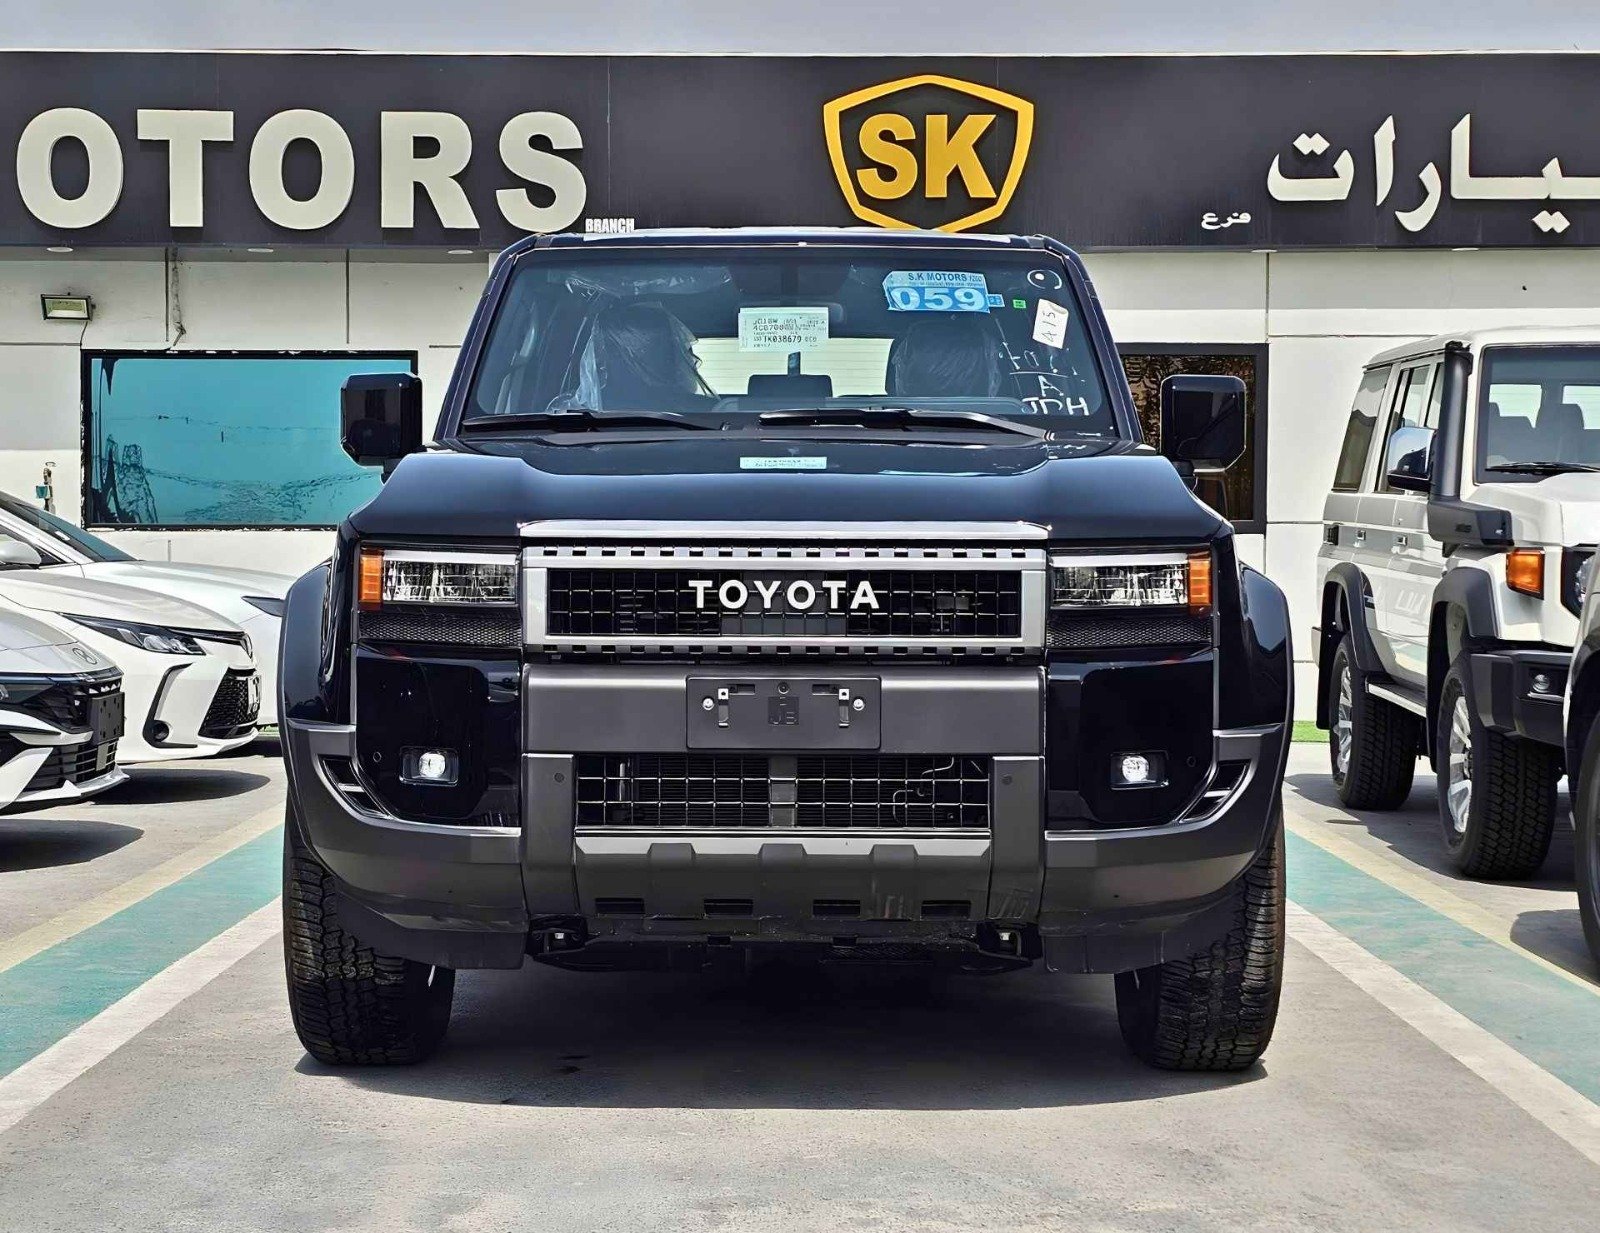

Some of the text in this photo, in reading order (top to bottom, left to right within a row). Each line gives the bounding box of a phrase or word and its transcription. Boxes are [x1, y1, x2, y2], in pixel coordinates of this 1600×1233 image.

[856, 113, 997, 200] SK
[16, 107, 588, 233] OTORS
[585, 218, 635, 233] BRANCH
[1201, 212, 1252, 230] فرع
[908, 272, 924, 281] S.K
[927, 273, 967, 282] MOTORS
[890, 287, 985, 311] 059
[688, 579, 880, 610] TOYOTA
